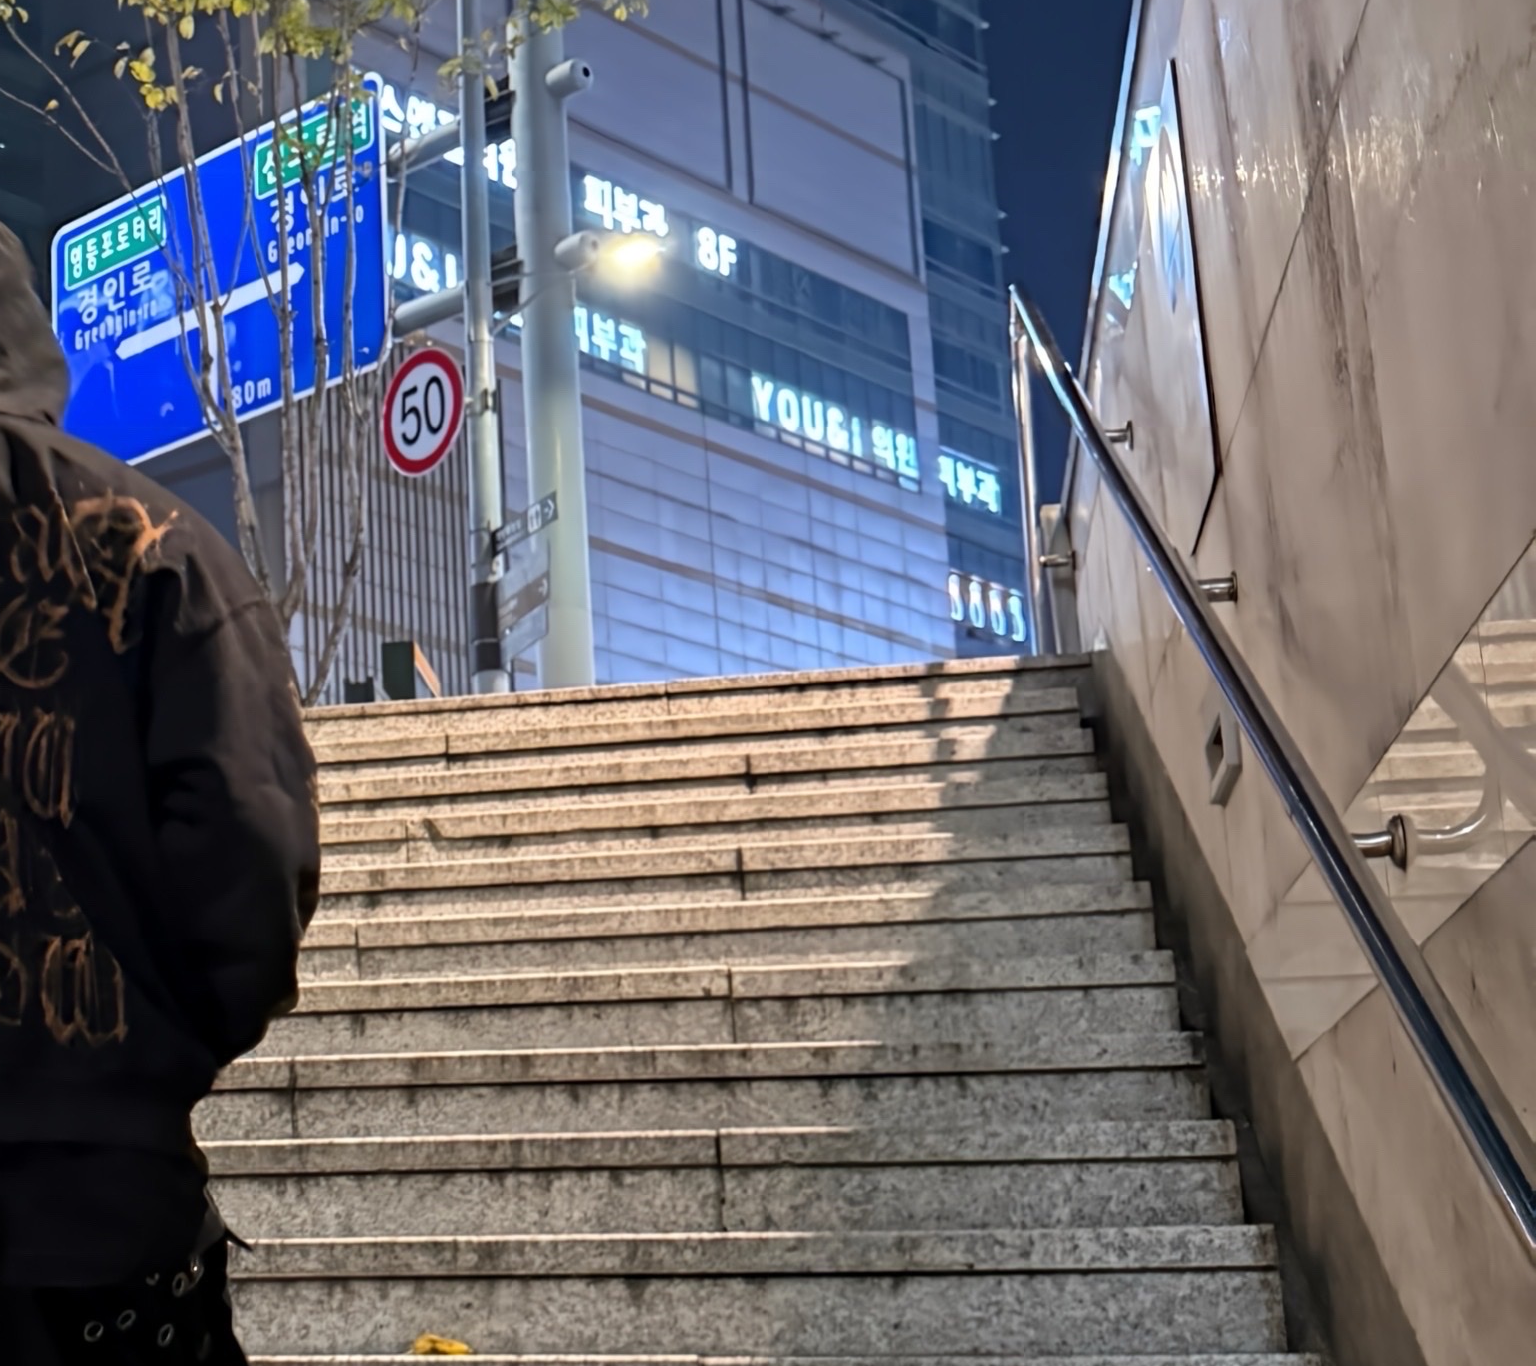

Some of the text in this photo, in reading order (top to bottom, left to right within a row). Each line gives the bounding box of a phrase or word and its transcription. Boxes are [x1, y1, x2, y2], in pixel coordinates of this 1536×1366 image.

[70, 205, 162, 279] 영등포로터리
[583, 174, 737, 277] 피부과 8F
[77, 260, 152, 325] 경인로
[401, 375, 445, 446] 50
[751, 375, 863, 458] YOU&I
[871, 425, 920, 479] 의원
